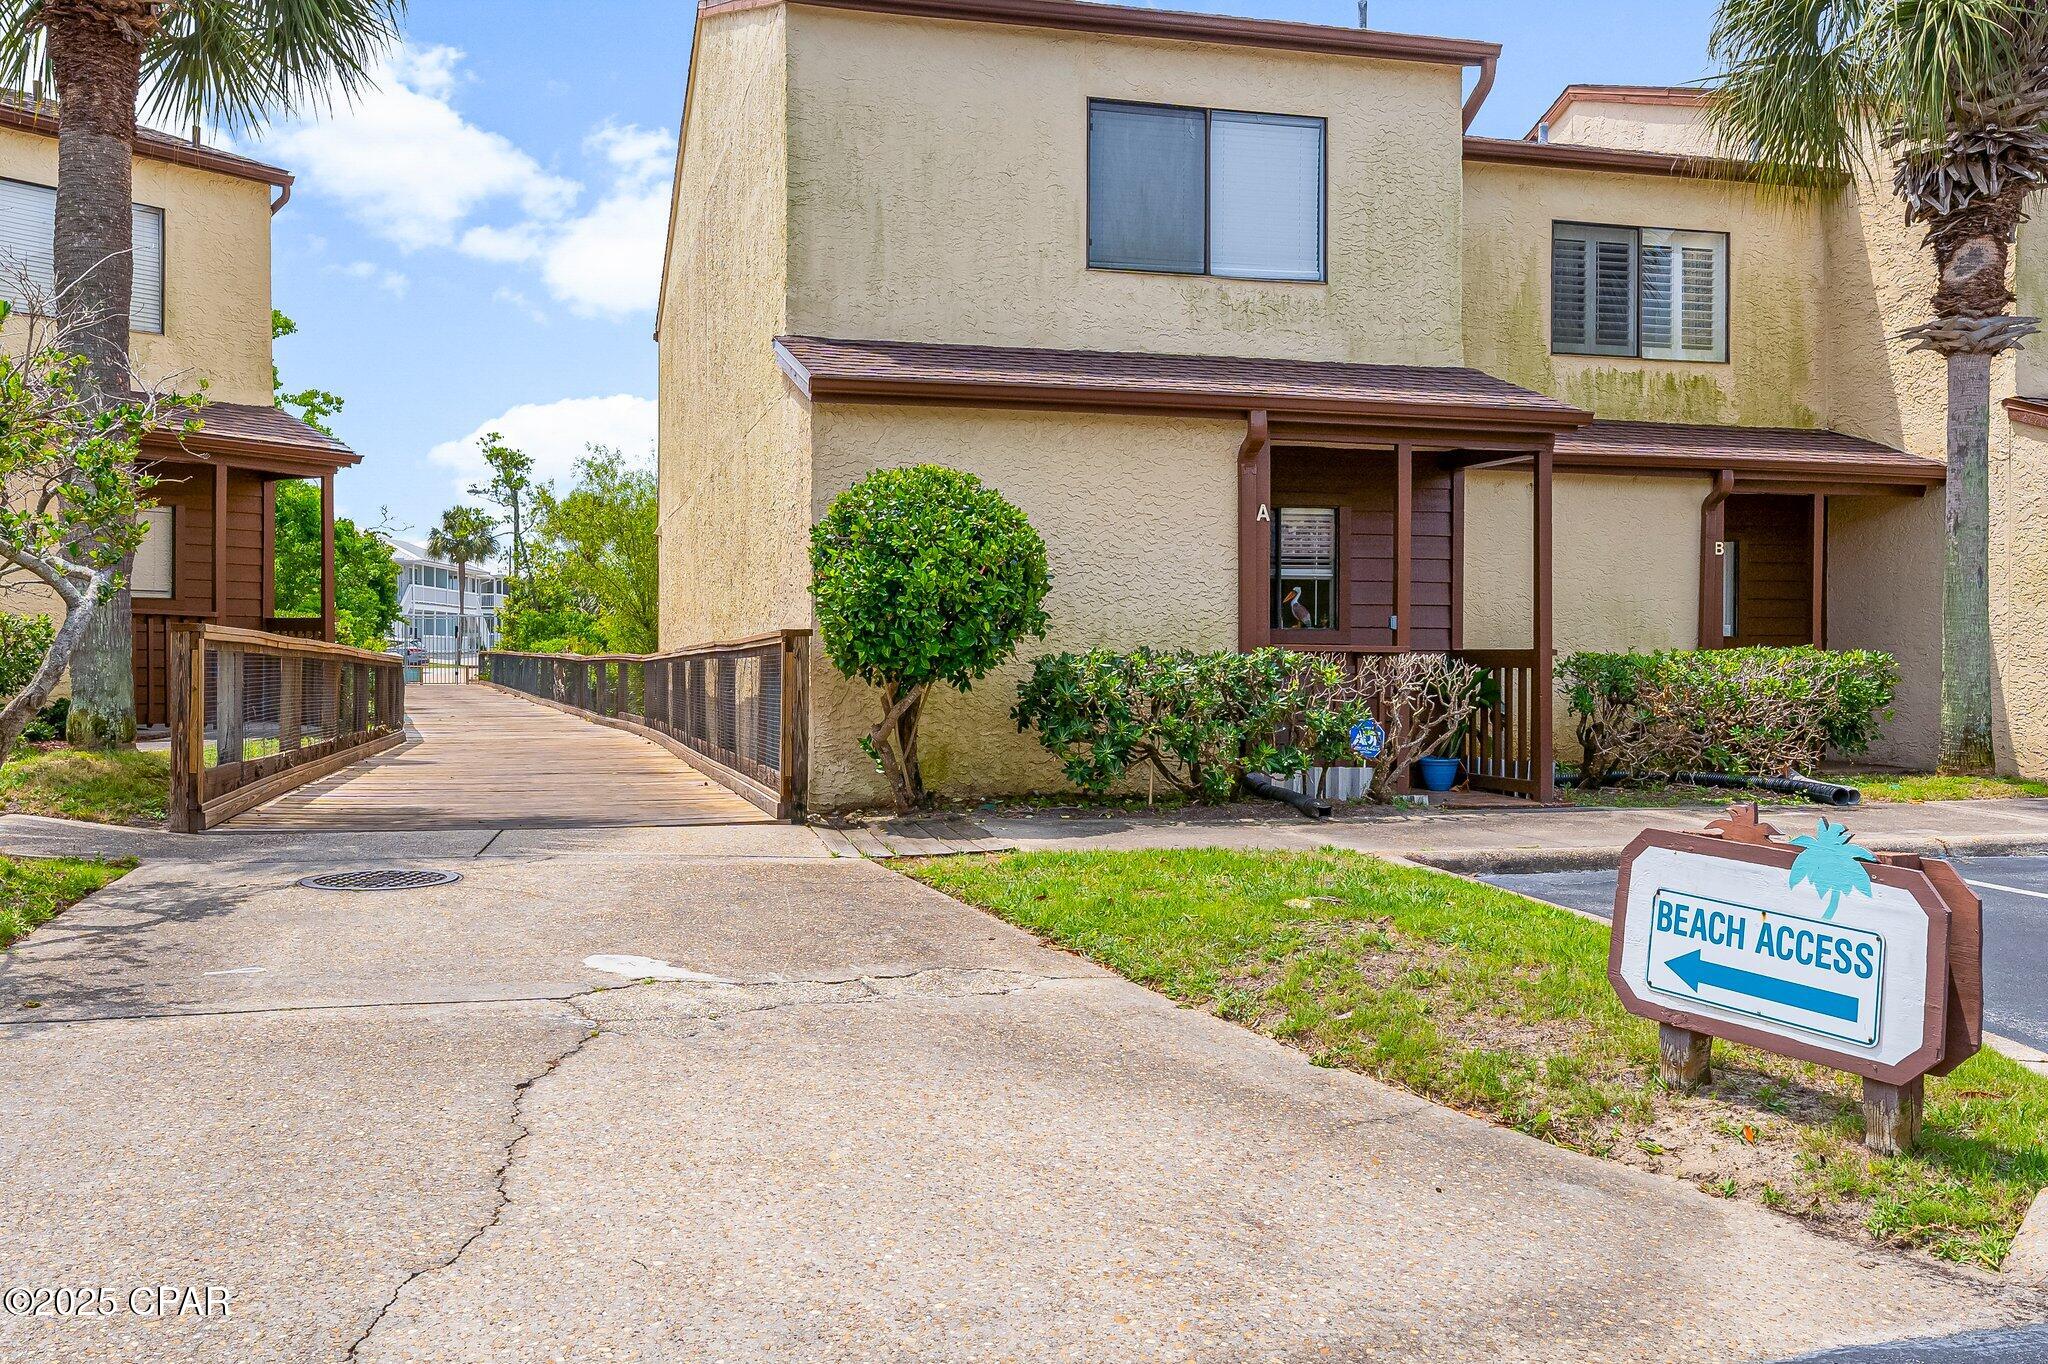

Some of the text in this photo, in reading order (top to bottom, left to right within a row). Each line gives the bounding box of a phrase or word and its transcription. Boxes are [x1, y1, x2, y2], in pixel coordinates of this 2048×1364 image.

[1256, 503, 1270, 521] A
[1715, 541, 1725, 555] B
[1656, 900, 1874, 979] BEACH ACCESS
